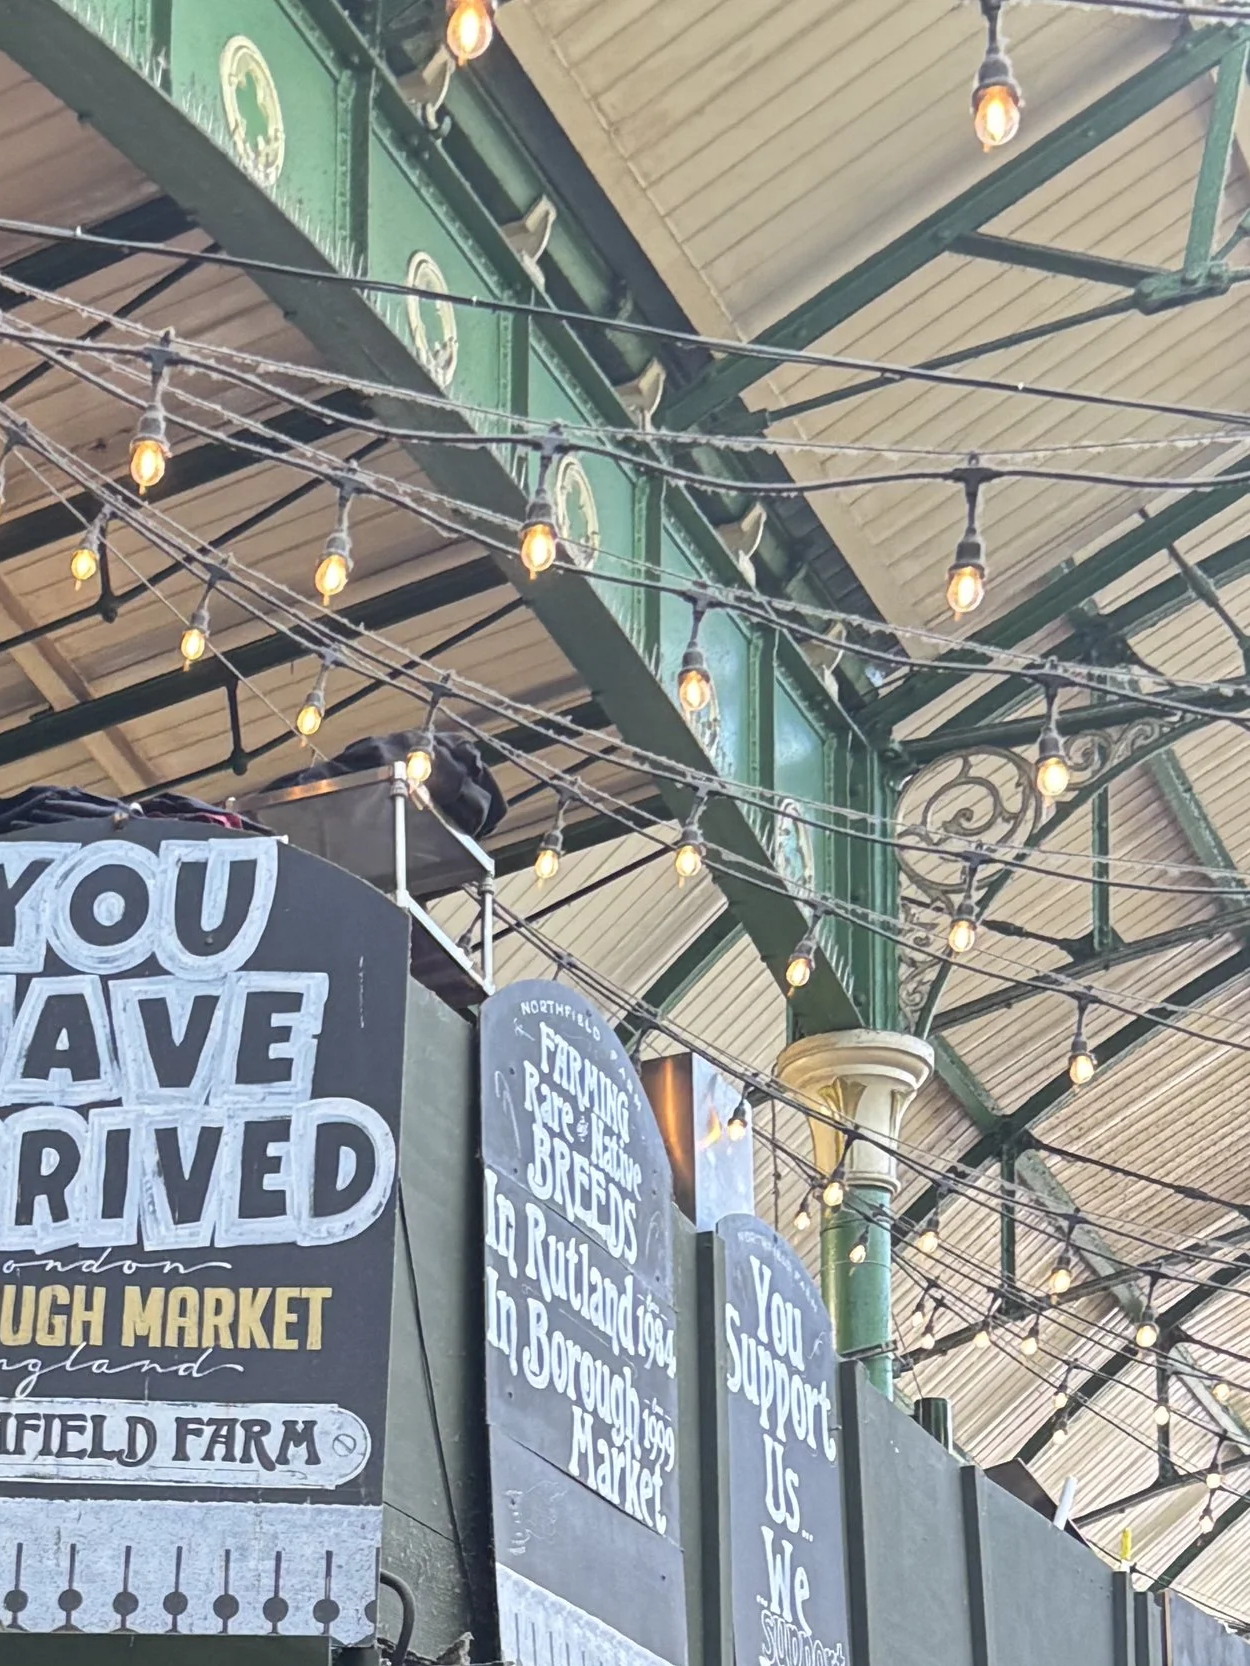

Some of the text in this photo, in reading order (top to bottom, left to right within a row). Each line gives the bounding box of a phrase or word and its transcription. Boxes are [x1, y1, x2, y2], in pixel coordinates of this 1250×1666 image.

[520, 999, 601, 1042] NORTHFIELD
[539, 1021, 630, 1143] FARMING
[523, 1060, 574, 1143] Rare
[591, 1112, 642, 1201] Native
[527, 1123, 638, 1264] BREEDS
[120, 1286, 333, 1351] MARKET
[484, 1168, 518, 1278] In
[525, 1203, 634, 1356] Rutland
[750, 1255, 805, 1371] You
[486, 1266, 676, 1473] In Borough 1999
[725, 1303, 837, 1462] Support
[173, 1415, 322, 1468] FARM
[569, 1405, 667, 1536] Market
